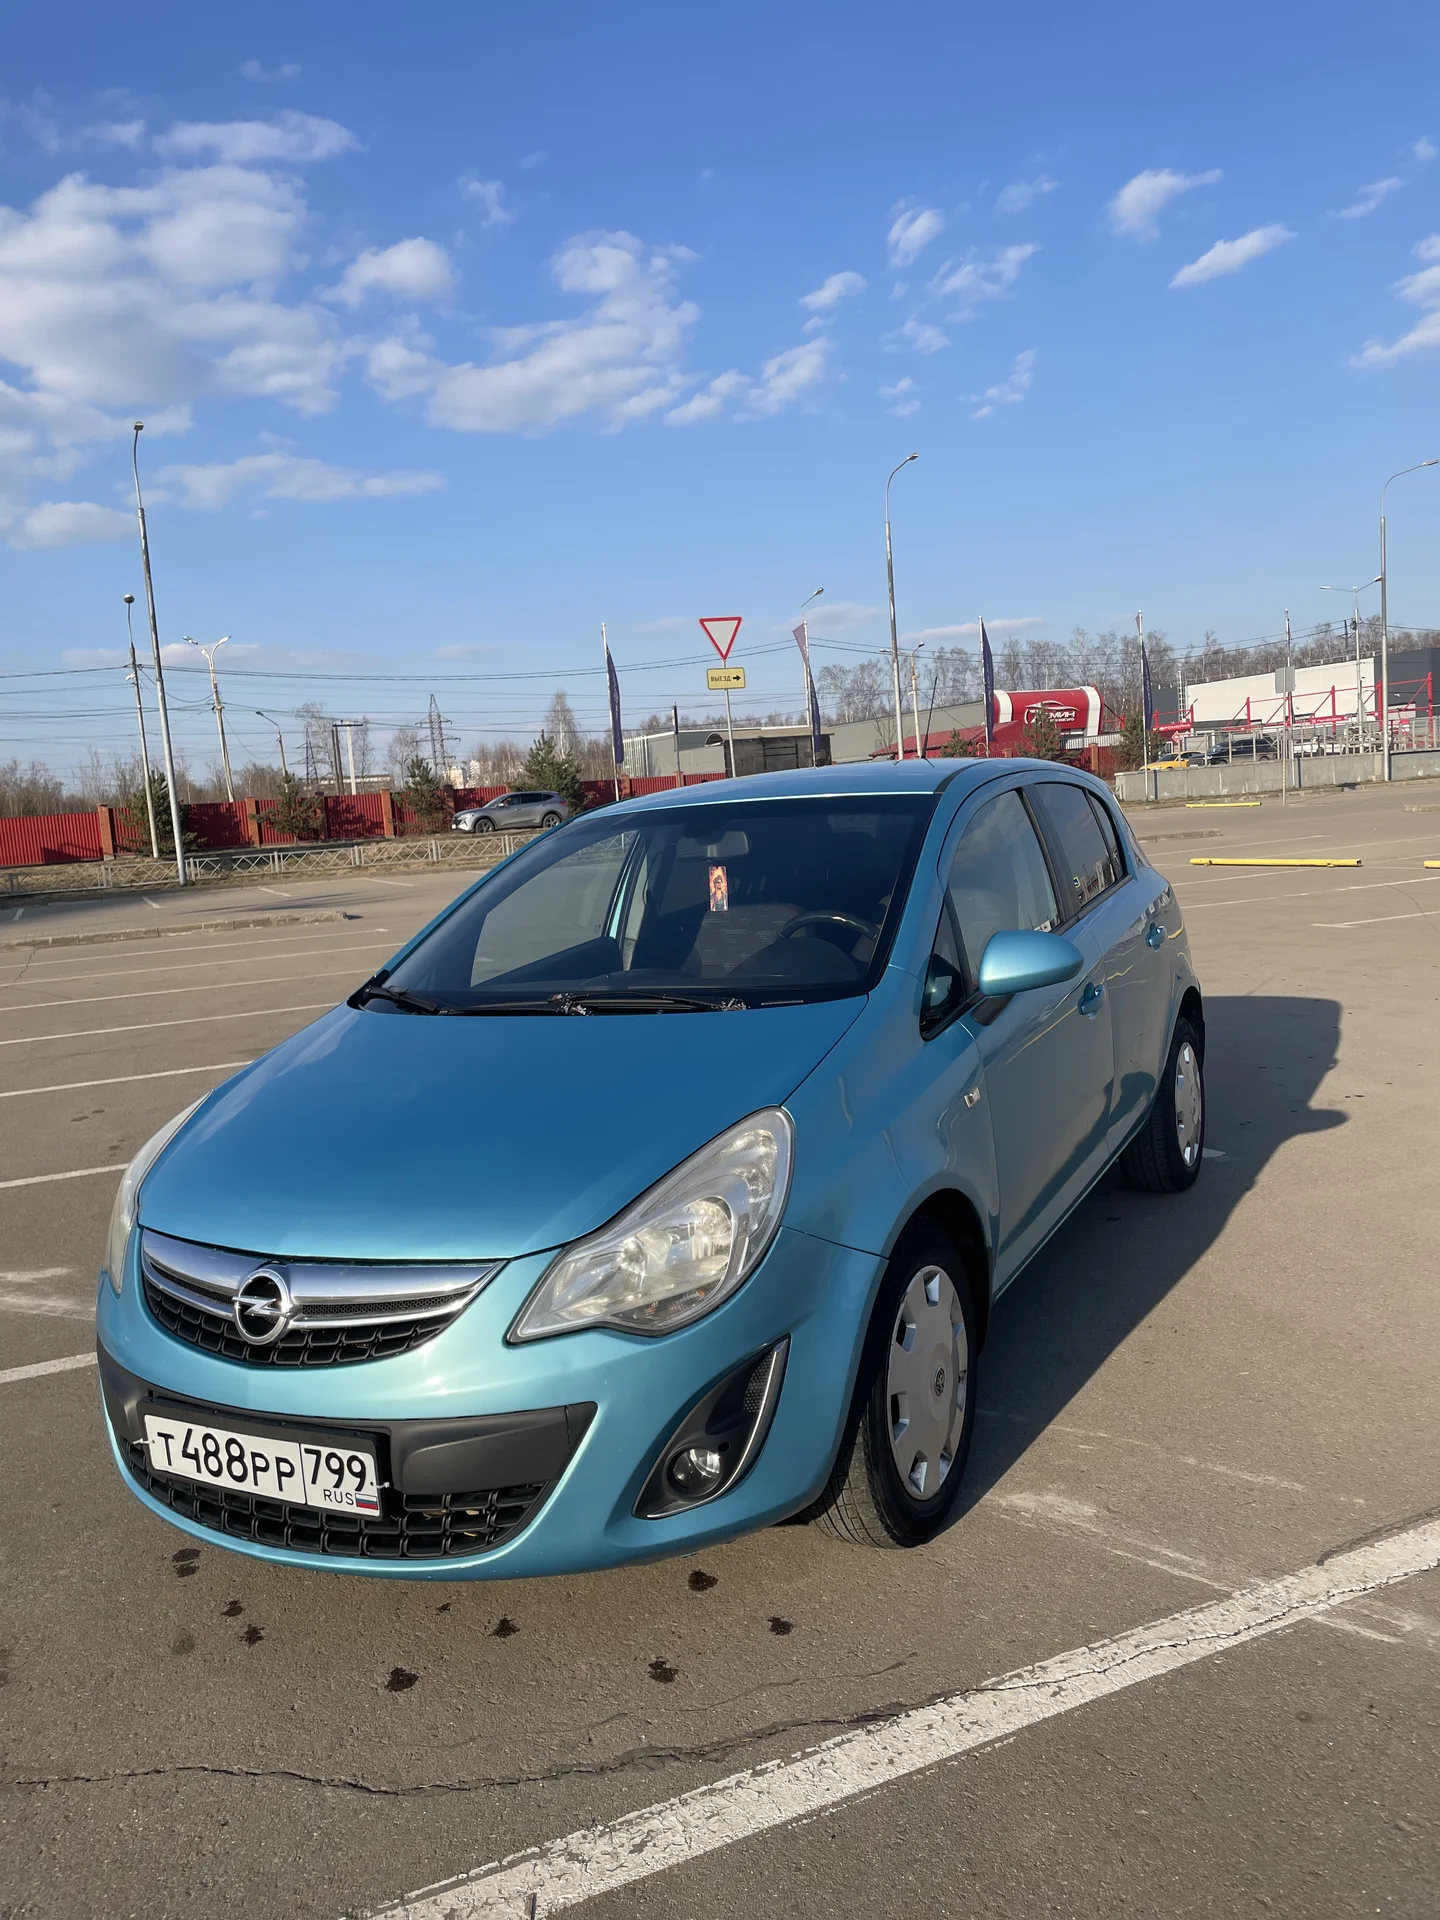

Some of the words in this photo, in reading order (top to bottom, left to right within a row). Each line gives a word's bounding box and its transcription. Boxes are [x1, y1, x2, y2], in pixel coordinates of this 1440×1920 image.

[157, 1428, 295, 1492] Т488РР
[304, 1448, 366, 1492] 799
[323, 1488, 354, 1506] RUS
